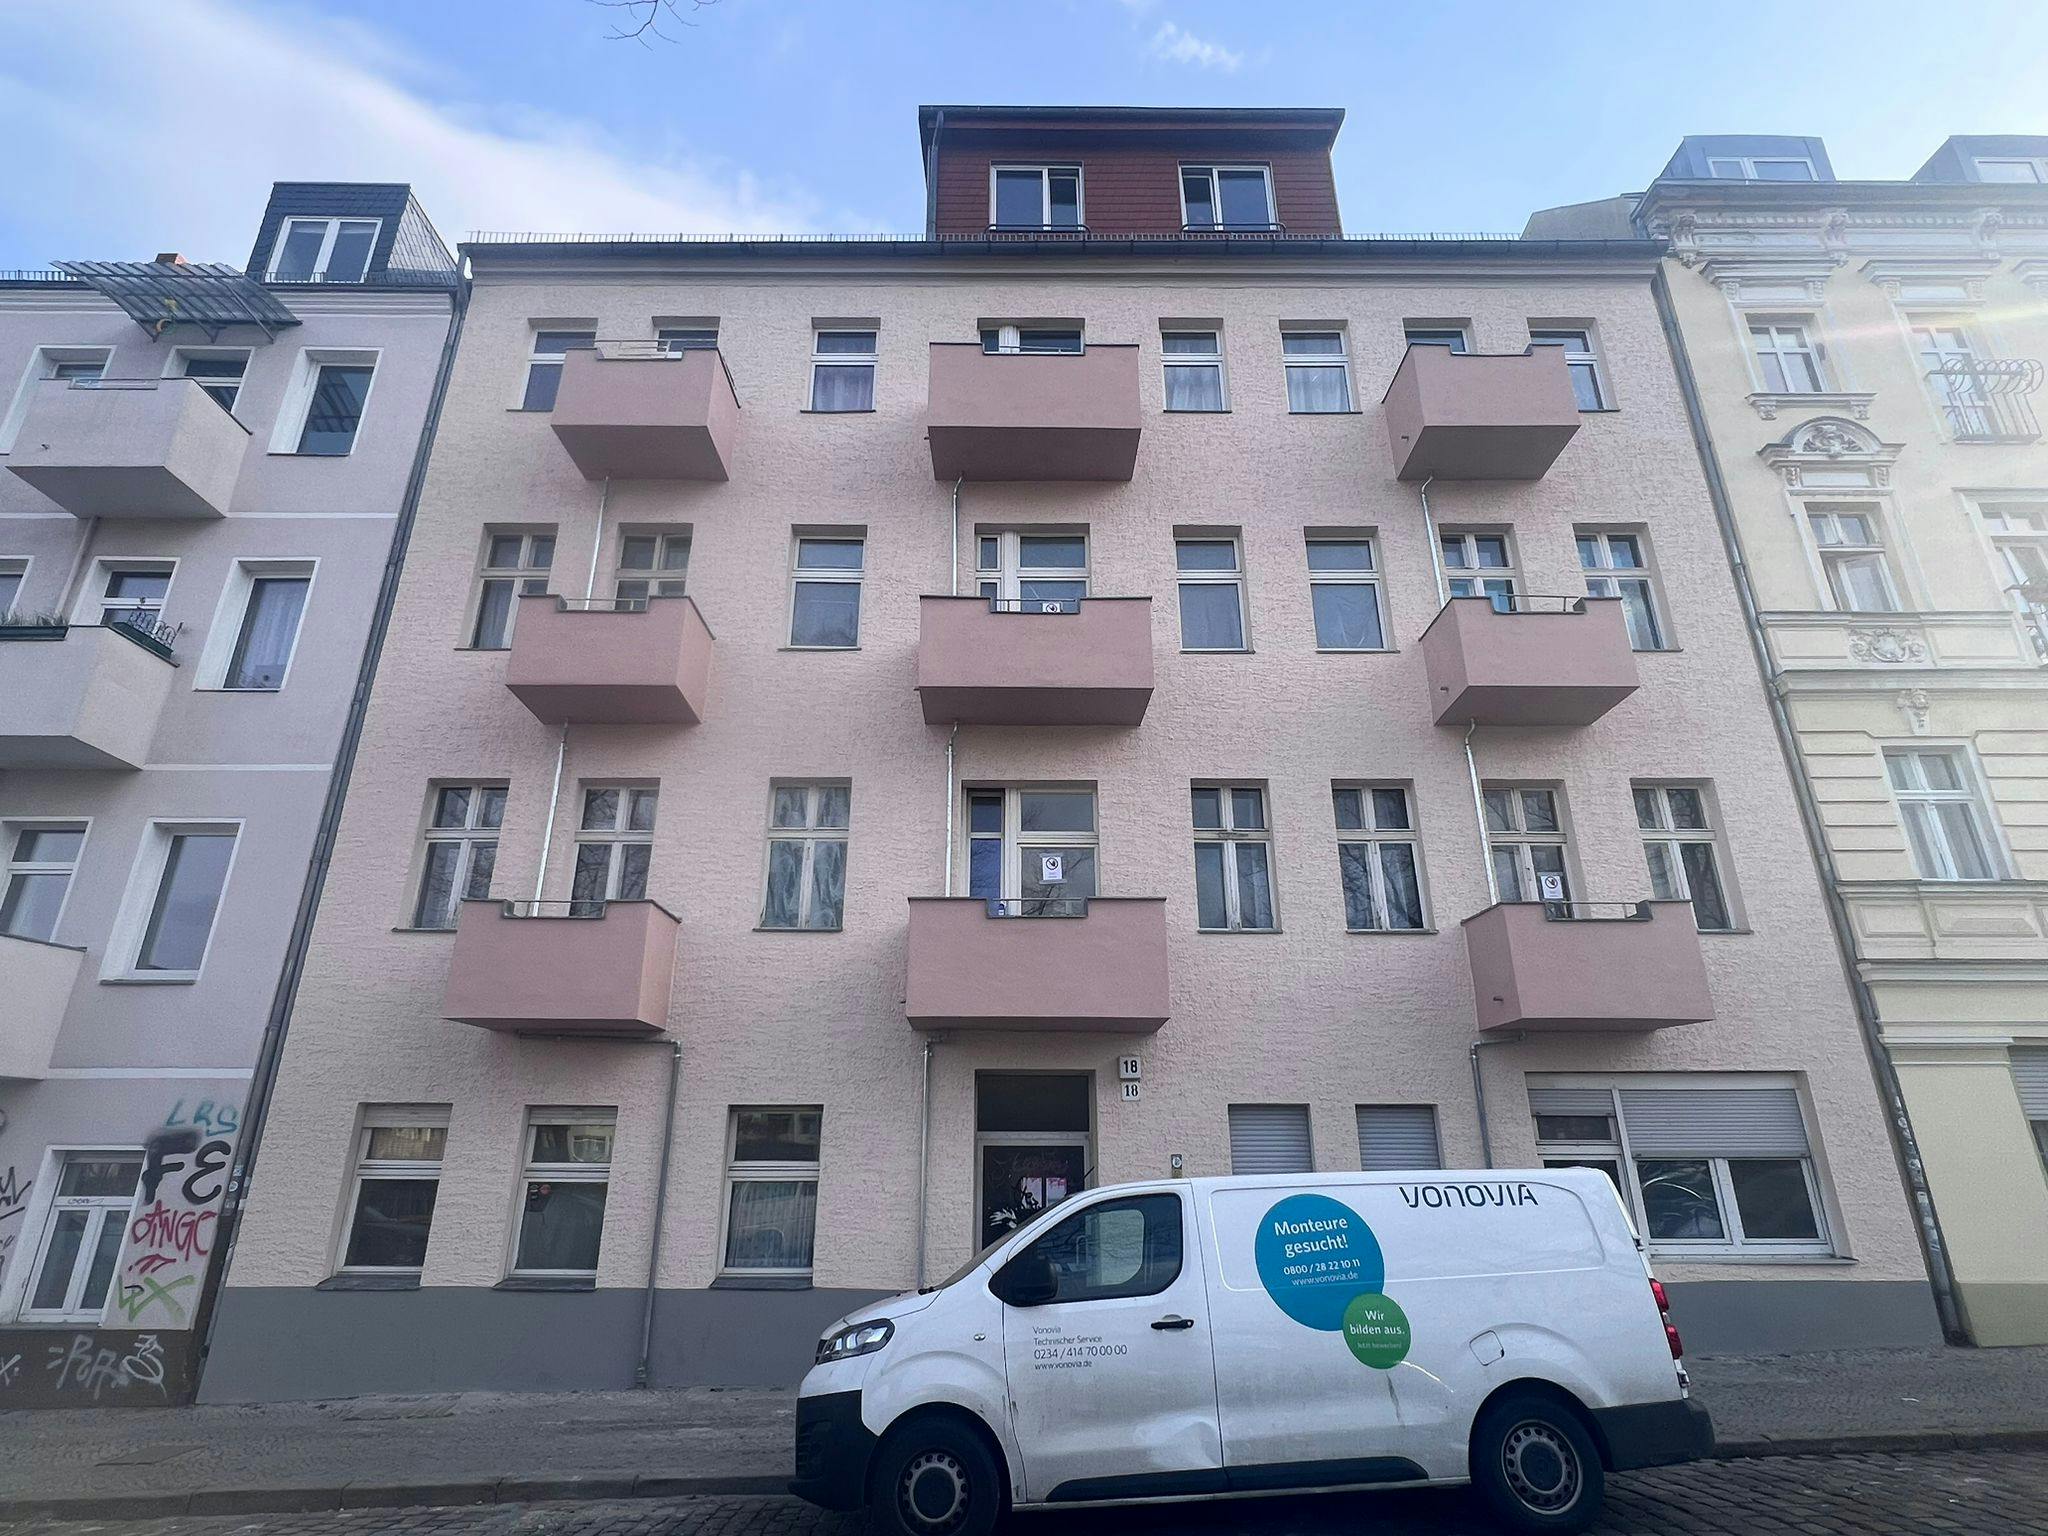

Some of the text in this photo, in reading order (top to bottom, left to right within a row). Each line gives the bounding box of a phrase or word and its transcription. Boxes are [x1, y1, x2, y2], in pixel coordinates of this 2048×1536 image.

[1123, 1060, 1138, 1074] 18
[1124, 1084, 1139, 1097] 18
[1274, 1218, 1349, 1236] Monteure
[1285, 1233, 1349, 1258] gesucht!
[1283, 1264, 1308, 1275] 0800
[1314, 1262, 1327, 1272] 28
[1328, 1261, 1340, 1270] 22
[1340, 1259, 1351, 1269] 10
[1352, 1258, 1361, 1267] 11
[1291, 1270, 1359, 1286] www.vonovia.de
[1364, 1310, 1385, 1320] Wir
[1032, 1326, 1062, 1334] Vonovia
[1349, 1323, 1406, 1335] bilden aus.
[1033, 1334, 1103, 1346] Technischer Service
[1033, 1348, 1058, 1360] 0234
[1066, 1347, 1083, 1357] 414
[1085, 1345, 1098, 1357] 70
[1099, 1345, 1113, 1356] 00
[1114, 1344, 1128, 1355] 00
[1034, 1360, 1093, 1370] www.vonovia.de
